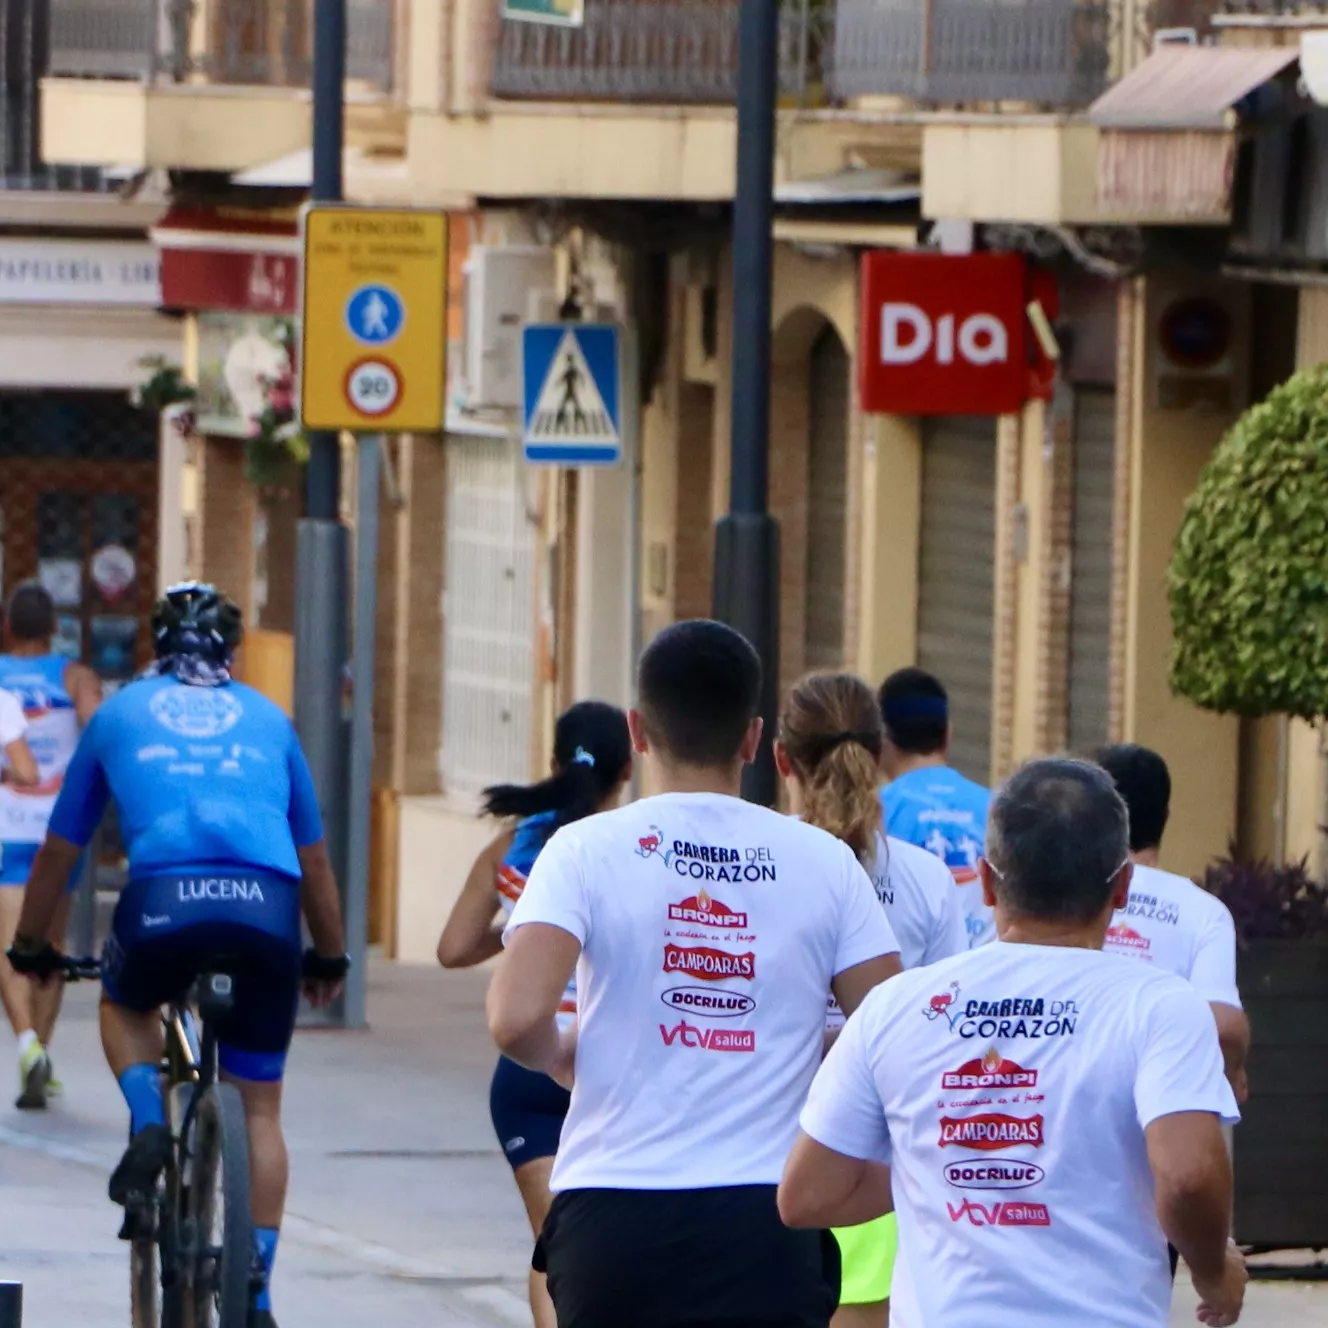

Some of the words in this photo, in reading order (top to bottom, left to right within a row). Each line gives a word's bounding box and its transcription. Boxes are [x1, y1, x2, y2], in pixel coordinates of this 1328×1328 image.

[358, 375, 390, 399] 20
[673, 840, 740, 863] CARRERA
[745, 847, 775, 862] DEL
[675, 859, 777, 883] CORAZÓN
[179, 879, 265, 903] LUCENA
[670, 907, 746, 926] BRONPI
[667, 950, 751, 975] CAMPOARAS
[672, 992, 749, 1010] DOCRILUC
[965, 998, 1045, 1018] CARRERA
[959, 1015, 1077, 1039] CORAZÓN
[943, 1073, 1036, 1087] BRONPI
[944, 1121, 1039, 1142] CAMPOARAS
[950, 1168, 1036, 1181] DOCRILUC
